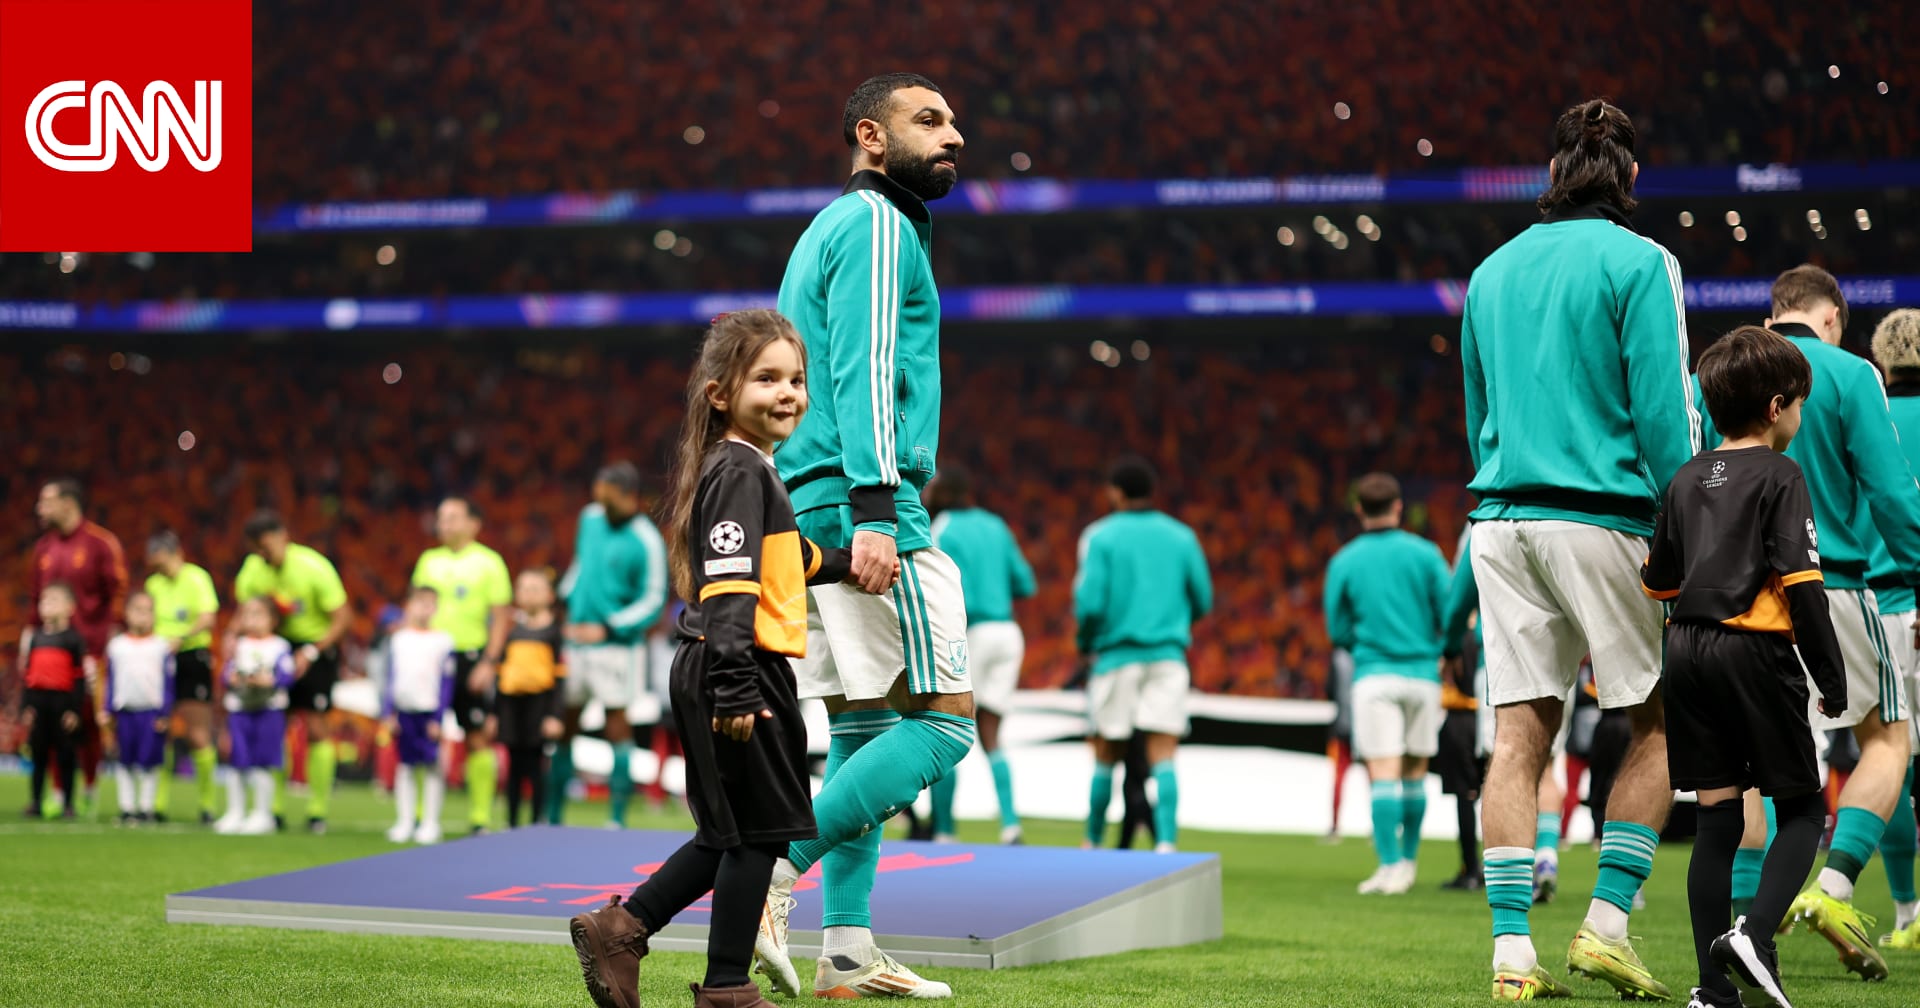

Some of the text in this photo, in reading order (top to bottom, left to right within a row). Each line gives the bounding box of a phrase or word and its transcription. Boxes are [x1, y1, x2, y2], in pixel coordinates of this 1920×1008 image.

[1700, 281, 1772, 307] CHAMP
[1845, 279, 1895, 304] AGUE
[1702, 477, 1728, 485] CHAMPIONS
